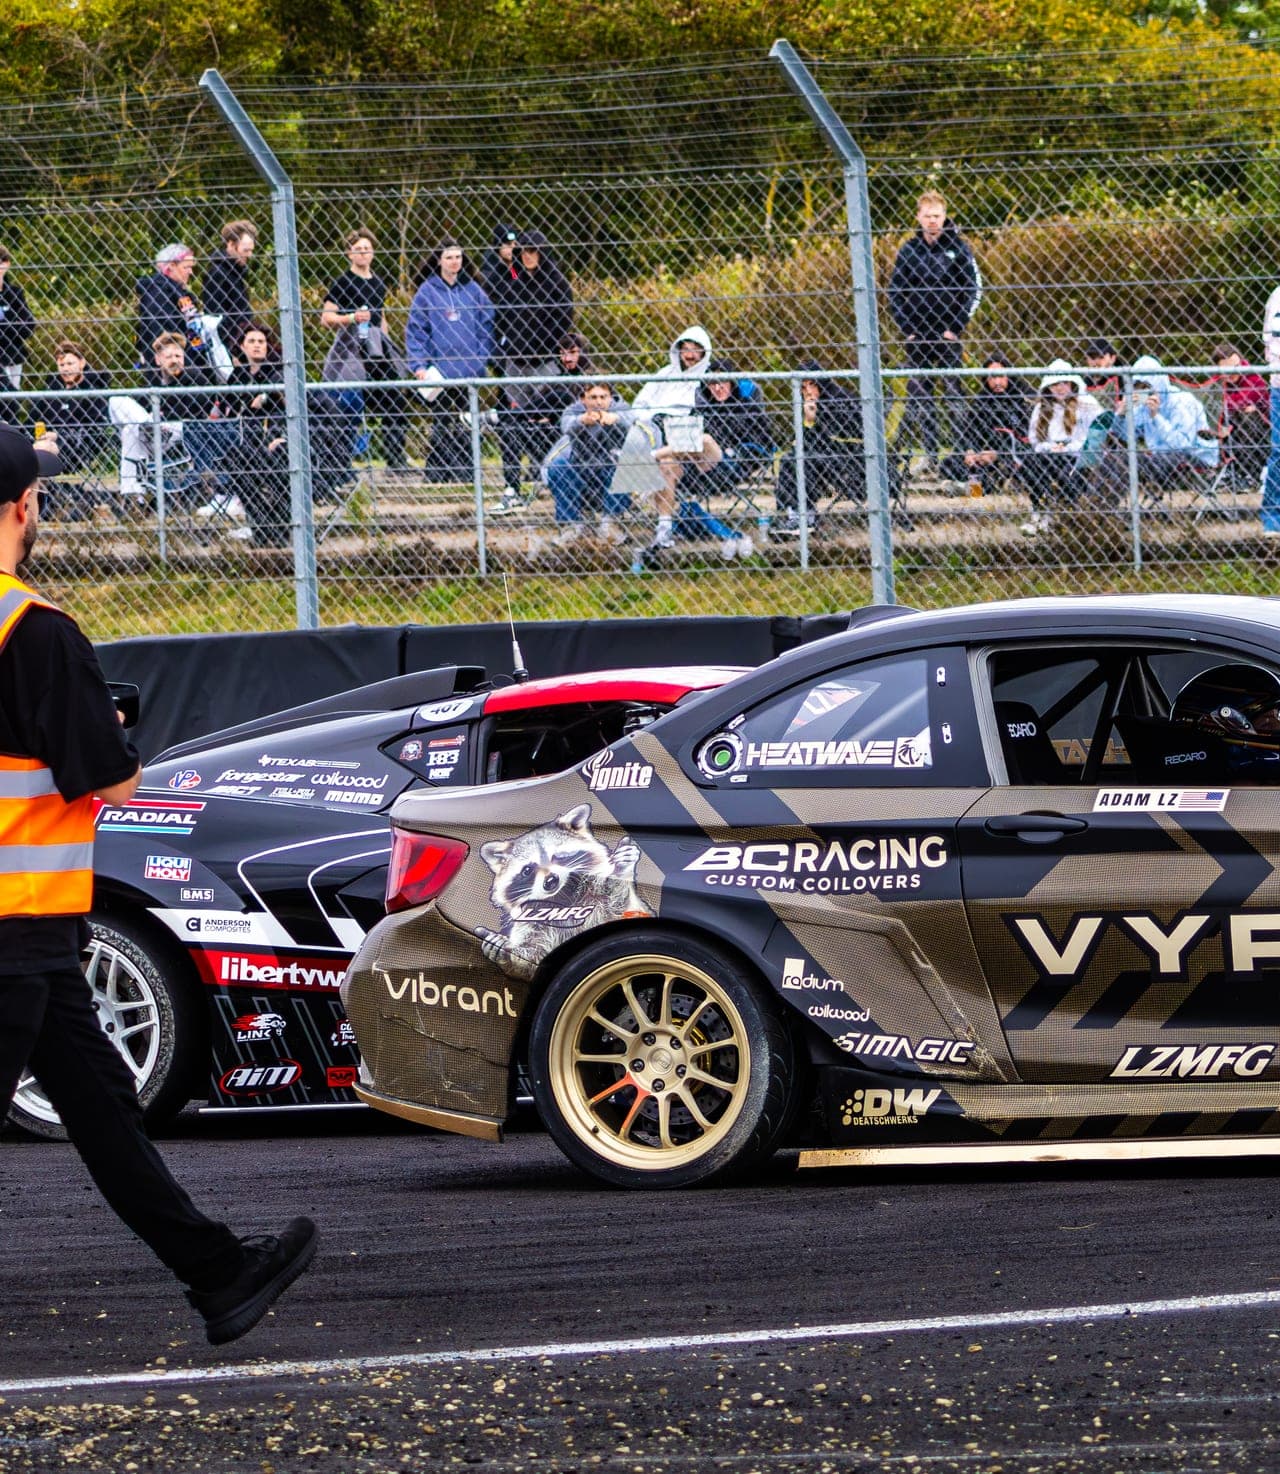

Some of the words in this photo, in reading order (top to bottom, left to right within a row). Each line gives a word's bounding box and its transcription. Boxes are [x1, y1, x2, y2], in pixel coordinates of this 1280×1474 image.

[746, 741, 895, 766] HEATWAVE
[1164, 751, 1207, 766] RECARO
[215, 769, 306, 784] forgestar
[311, 770, 389, 789] wilwood
[590, 763, 653, 790] ignite
[1099, 793, 1150, 807] ADAM
[1157, 793, 1179, 807] LZ
[103, 810, 197, 825] RADIAL
[149, 856, 191, 868] LIQUI
[148, 867, 190, 880] MOLY
[705, 874, 795, 889] CUSTOM
[803, 874, 921, 891] COILOVERS
[183, 889, 212, 900] BMS
[519, 905, 595, 921] LZMFG
[204, 926, 251, 934] COMPOSITES
[205, 919, 251, 927] ANDERSON
[784, 973, 844, 991] radium
[384, 972, 517, 1017] vibrant
[808, 1004, 870, 1022] wilwood
[835, 1032, 975, 1064] SIMAGIC
[1108, 1046, 1275, 1078] LZMFG
[863, 1089, 941, 1116] DW
[853, 1116, 919, 1126] DEATSCHWERKS
